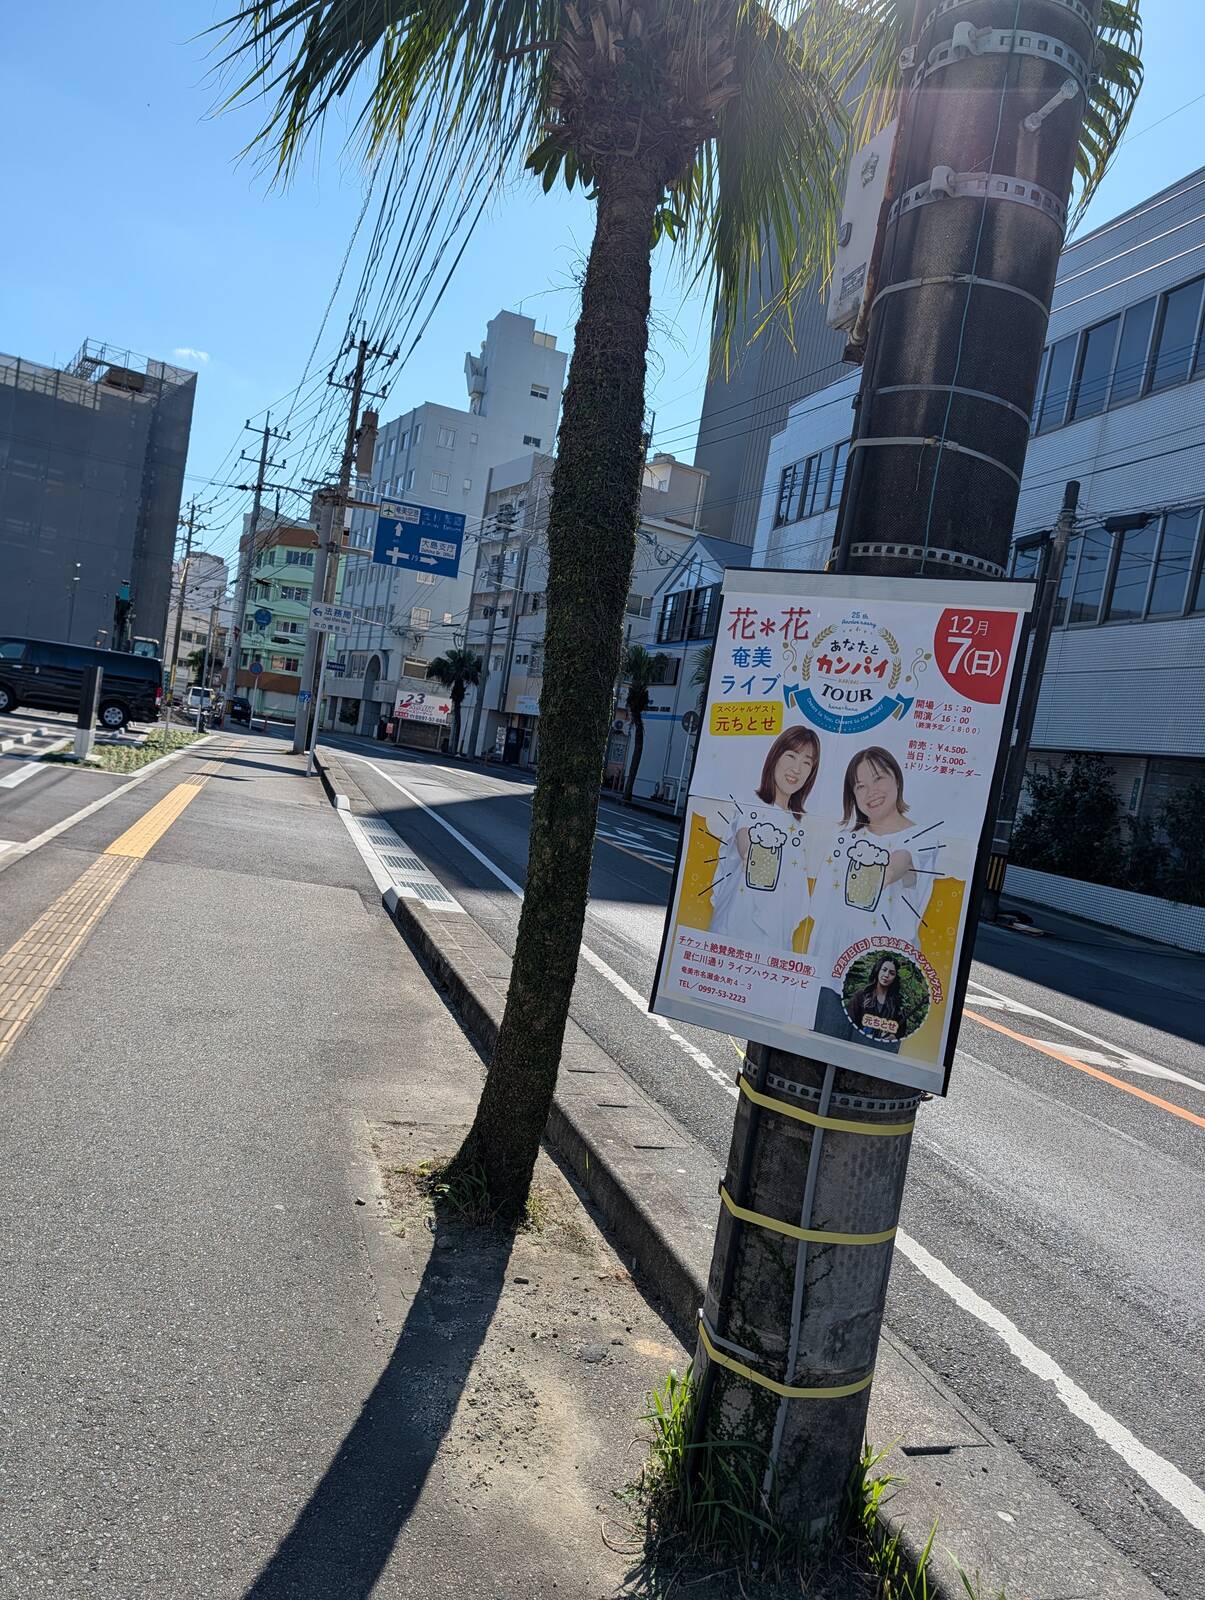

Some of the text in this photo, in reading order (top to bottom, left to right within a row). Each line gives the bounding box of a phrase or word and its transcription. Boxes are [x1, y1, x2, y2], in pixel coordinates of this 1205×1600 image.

[324, 607, 352, 619] 法務局
[948, 615, 989, 637] 12月
[830, 638, 879, 655] あなたと
[946, 636, 1002, 677] 7(日)
[732, 646, 772, 668] 奄美
[816, 654, 889, 679] カンパイ
[721, 673, 782, 695] ライブ
[820, 683, 874, 703] TOUR
[716, 704, 776, 714] スペシャルゲスト
[715, 716, 776, 732] 元ちとせ
[864, 1016, 897, 1031] 元ちとせ
